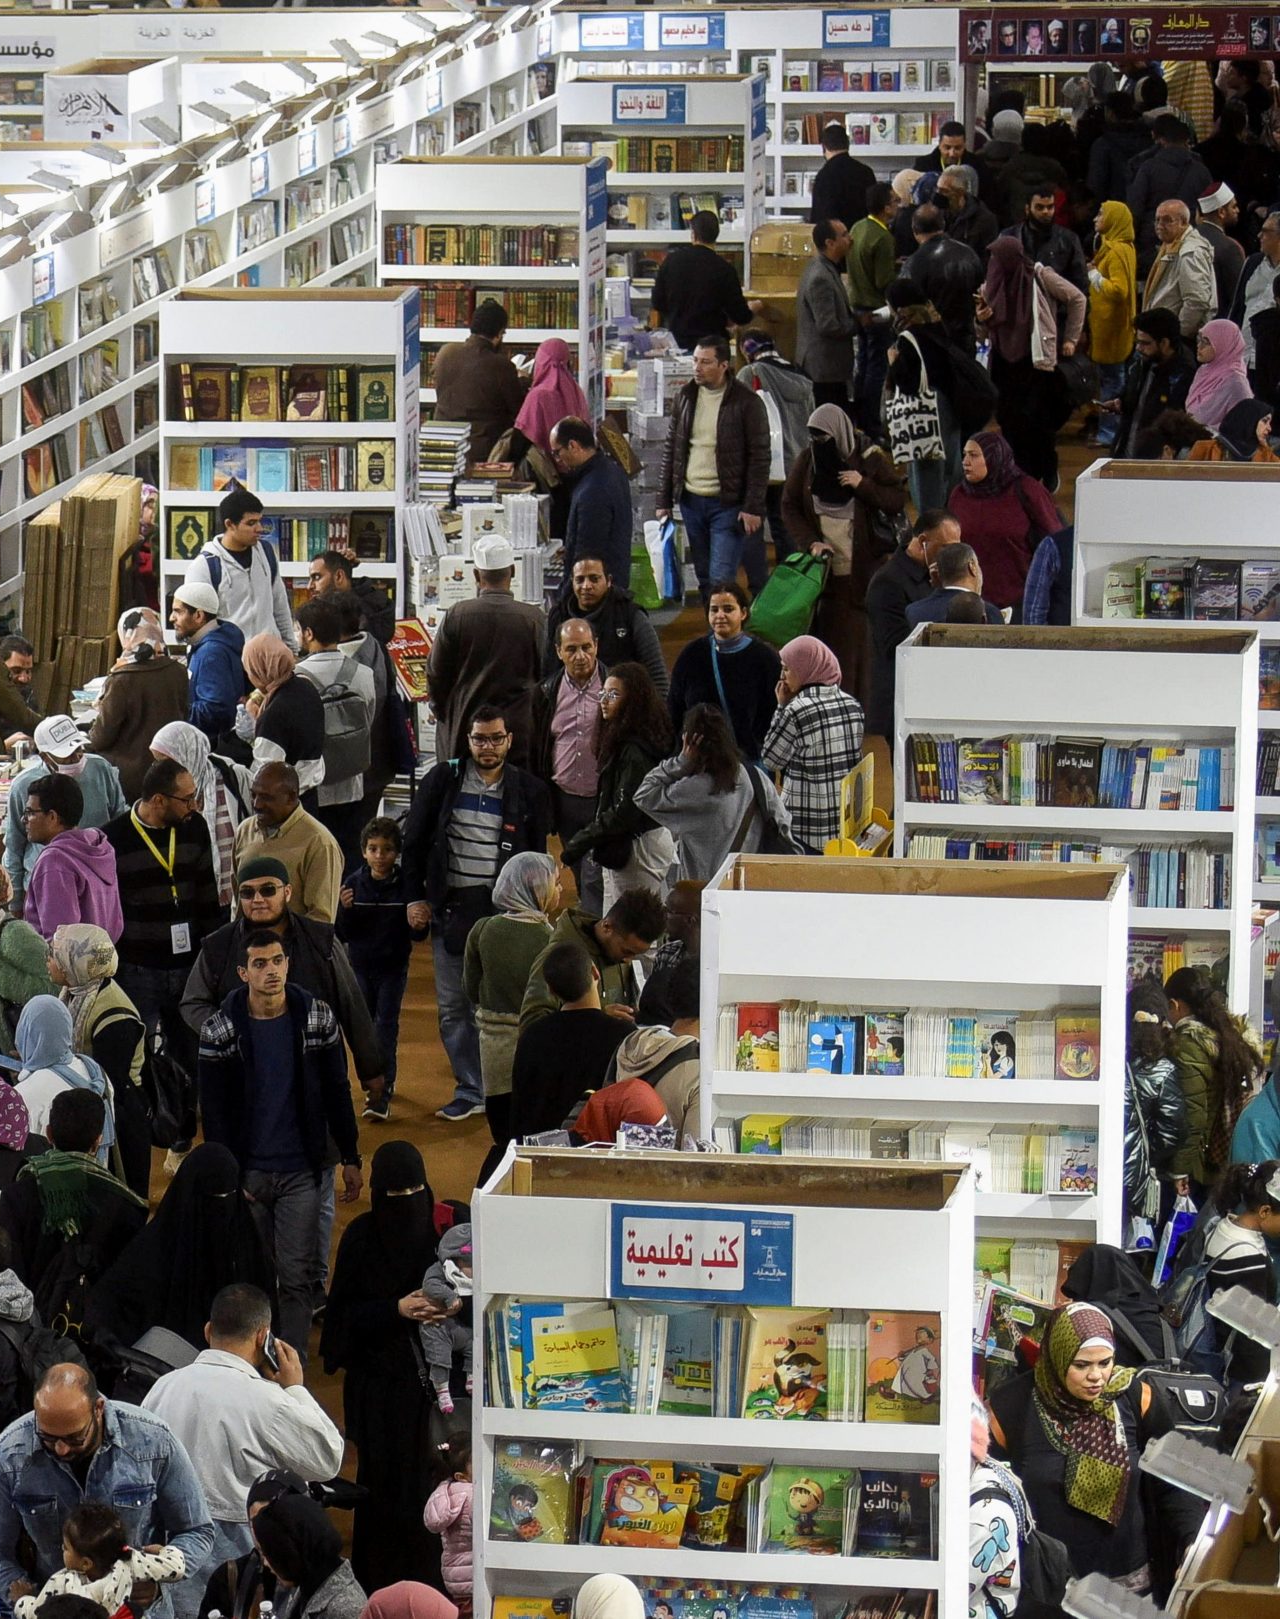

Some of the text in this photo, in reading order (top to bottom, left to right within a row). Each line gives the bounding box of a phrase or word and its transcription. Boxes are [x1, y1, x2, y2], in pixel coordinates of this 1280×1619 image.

[826, 20, 849, 36] حسين
[850, 20, 861, 32] طه
[1162, 13, 1195, 29] المعارف
[138, 26, 170, 41] الخزينة
[183, 26, 216, 41] الخزينة
[618, 94, 665, 116] اللغة والنحو
[751, 1228, 761, 1237] 54
[626, 1229, 740, 1281] كتب تعليمية
[655, 1471, 666, 1480] EQ
[674, 1487, 685, 1495] EQ
[865, 1480, 898, 1496] بجانب
[863, 1497, 899, 1513] والدي
